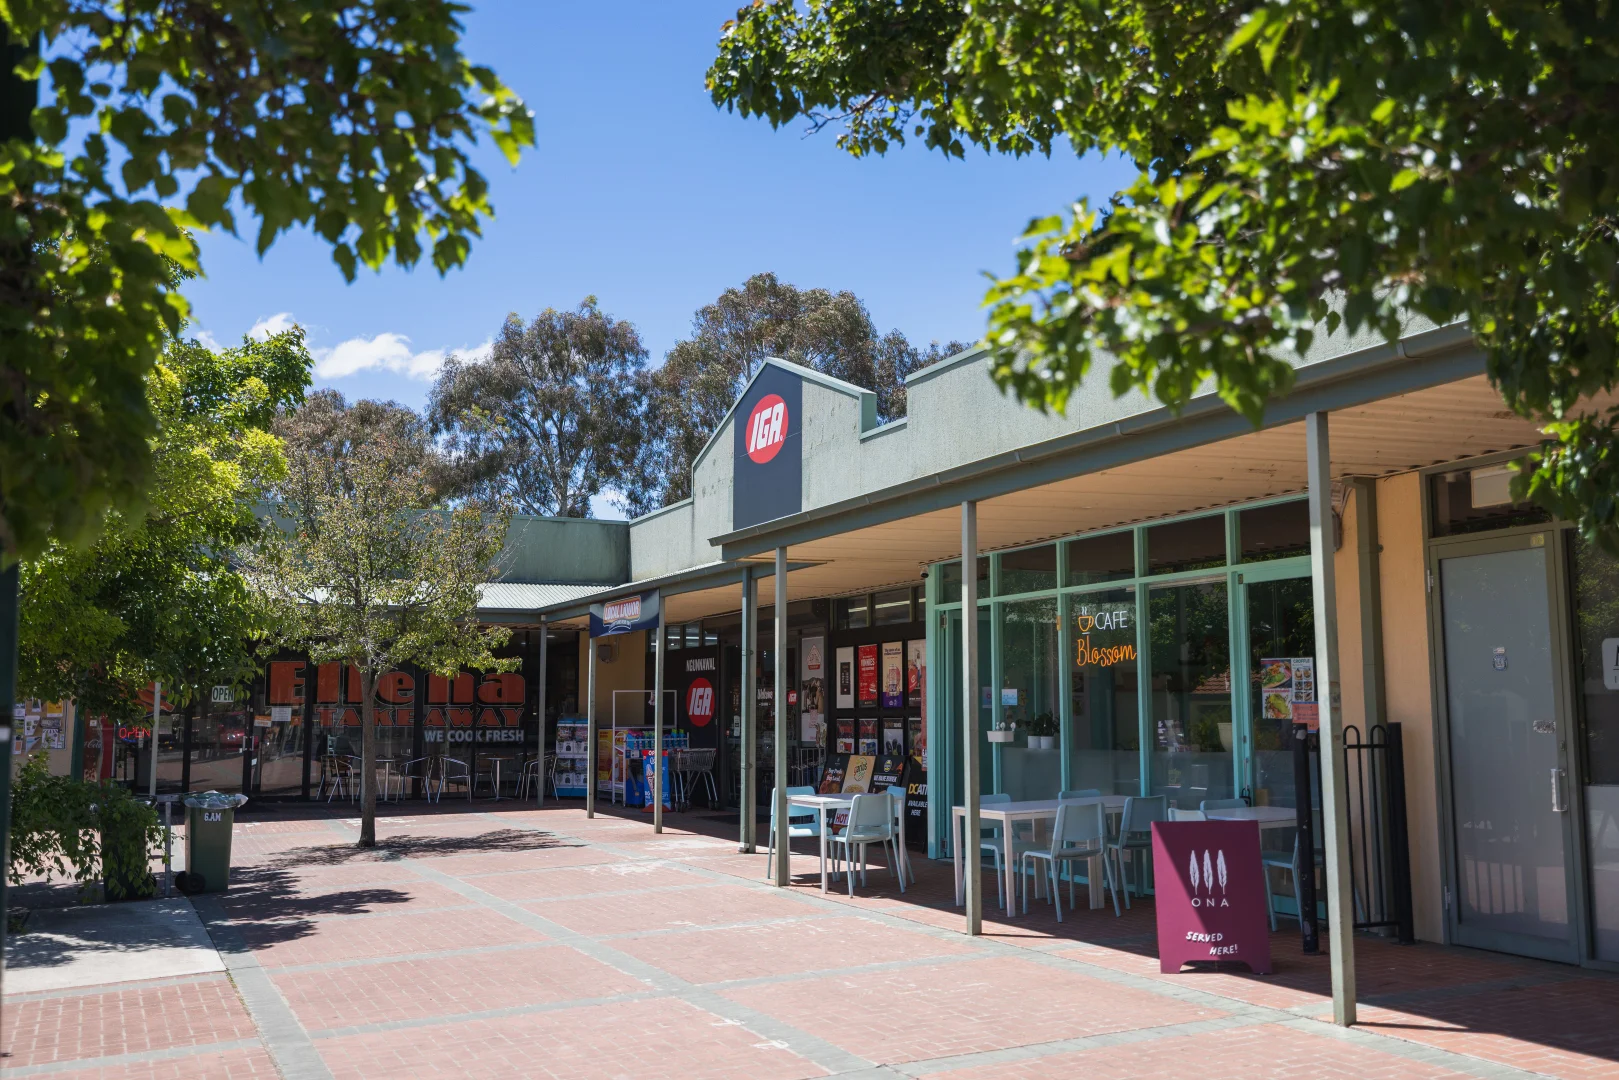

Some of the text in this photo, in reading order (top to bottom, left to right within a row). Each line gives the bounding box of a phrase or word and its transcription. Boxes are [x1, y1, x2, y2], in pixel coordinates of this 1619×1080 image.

[749, 402, 784, 453] IGA
[1095, 610, 1128, 630] CAFE
[1076, 635, 1137, 667] Blossom
[212, 687, 233, 701] OPEN
[688, 687, 713, 716] IGA
[316, 707, 524, 727] TAKEAWAY
[424, 729, 525, 743] WE COOK FRESH
[1185, 931, 1223, 943] SERVED
[1209, 944, 1238, 956] HERE!
